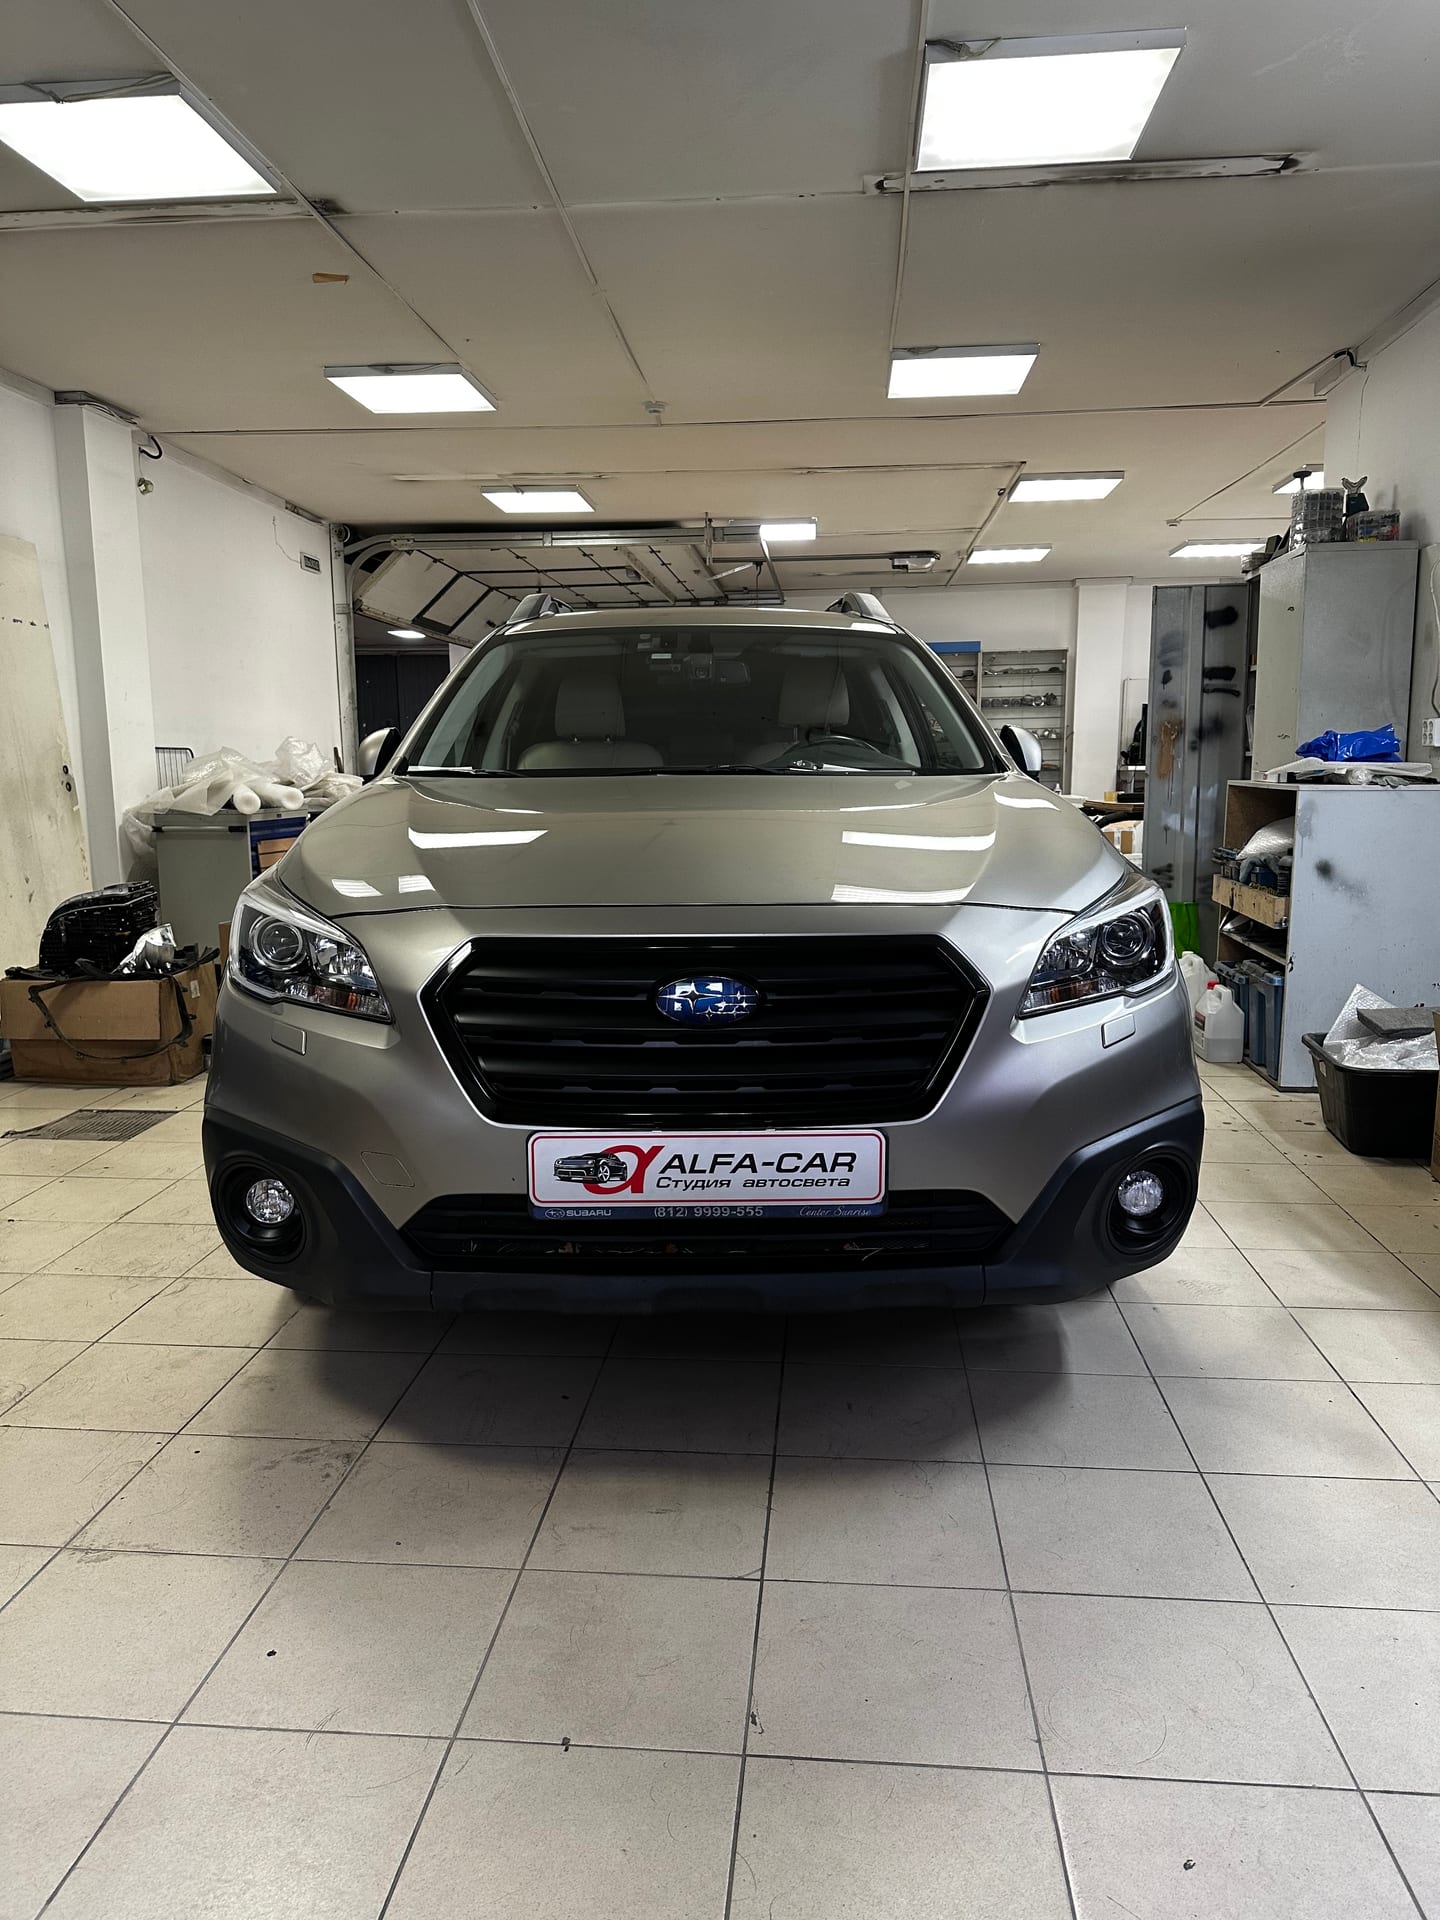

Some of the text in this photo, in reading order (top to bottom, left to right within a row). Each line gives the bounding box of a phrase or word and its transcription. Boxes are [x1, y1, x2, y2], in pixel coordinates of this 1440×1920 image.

[658, 1152, 857, 1175] ALFA-CAR
[656, 1176, 850, 1191] Студия автосвета
[566, 1209, 612, 1217] SUBARU
[654, 1206, 764, 1218] (812) 9999-555
[800, 1206, 830, 1217] Center
